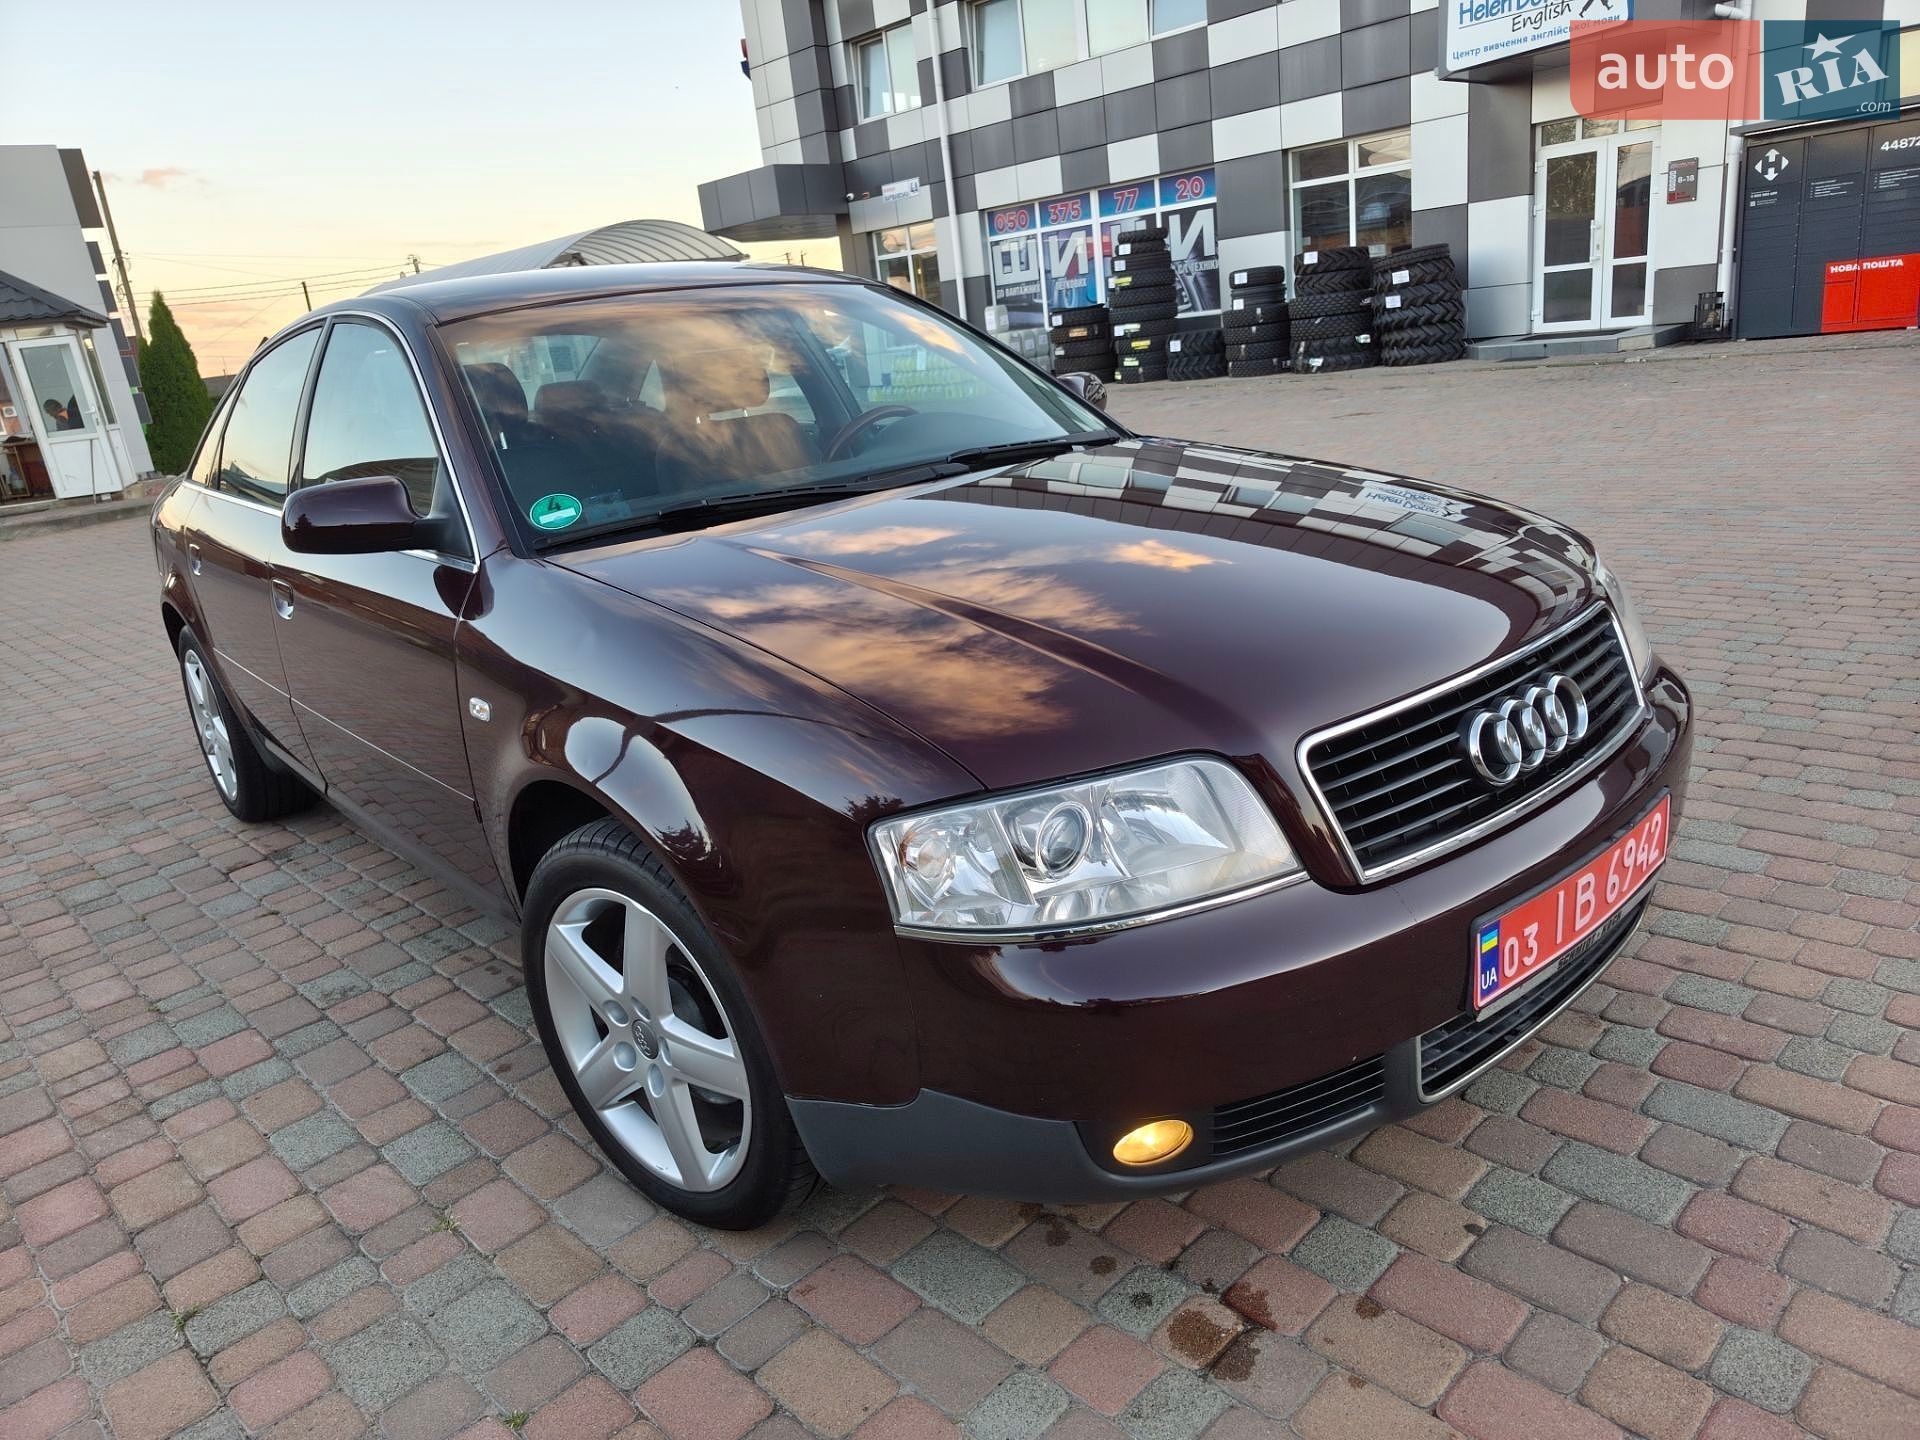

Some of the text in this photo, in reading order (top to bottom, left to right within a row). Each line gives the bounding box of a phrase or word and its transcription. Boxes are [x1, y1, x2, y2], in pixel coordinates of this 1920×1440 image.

[1459, 0, 1511, 24] Helen
[1512, 2, 1572, 32] English
[1452, 14, 1621, 60] Центр вивчення англійської мови
[994, 176, 1205, 234] 050 375 77 20
[1830, 258, 1904, 274] НОВА ПОШТА
[548, 496, 561, 511] 4
[1503, 921, 1539, 978] 03
[1556, 872, 1595, 945] IB
[1606, 812, 1662, 904] 6942
[1481, 967, 1498, 990] UA
